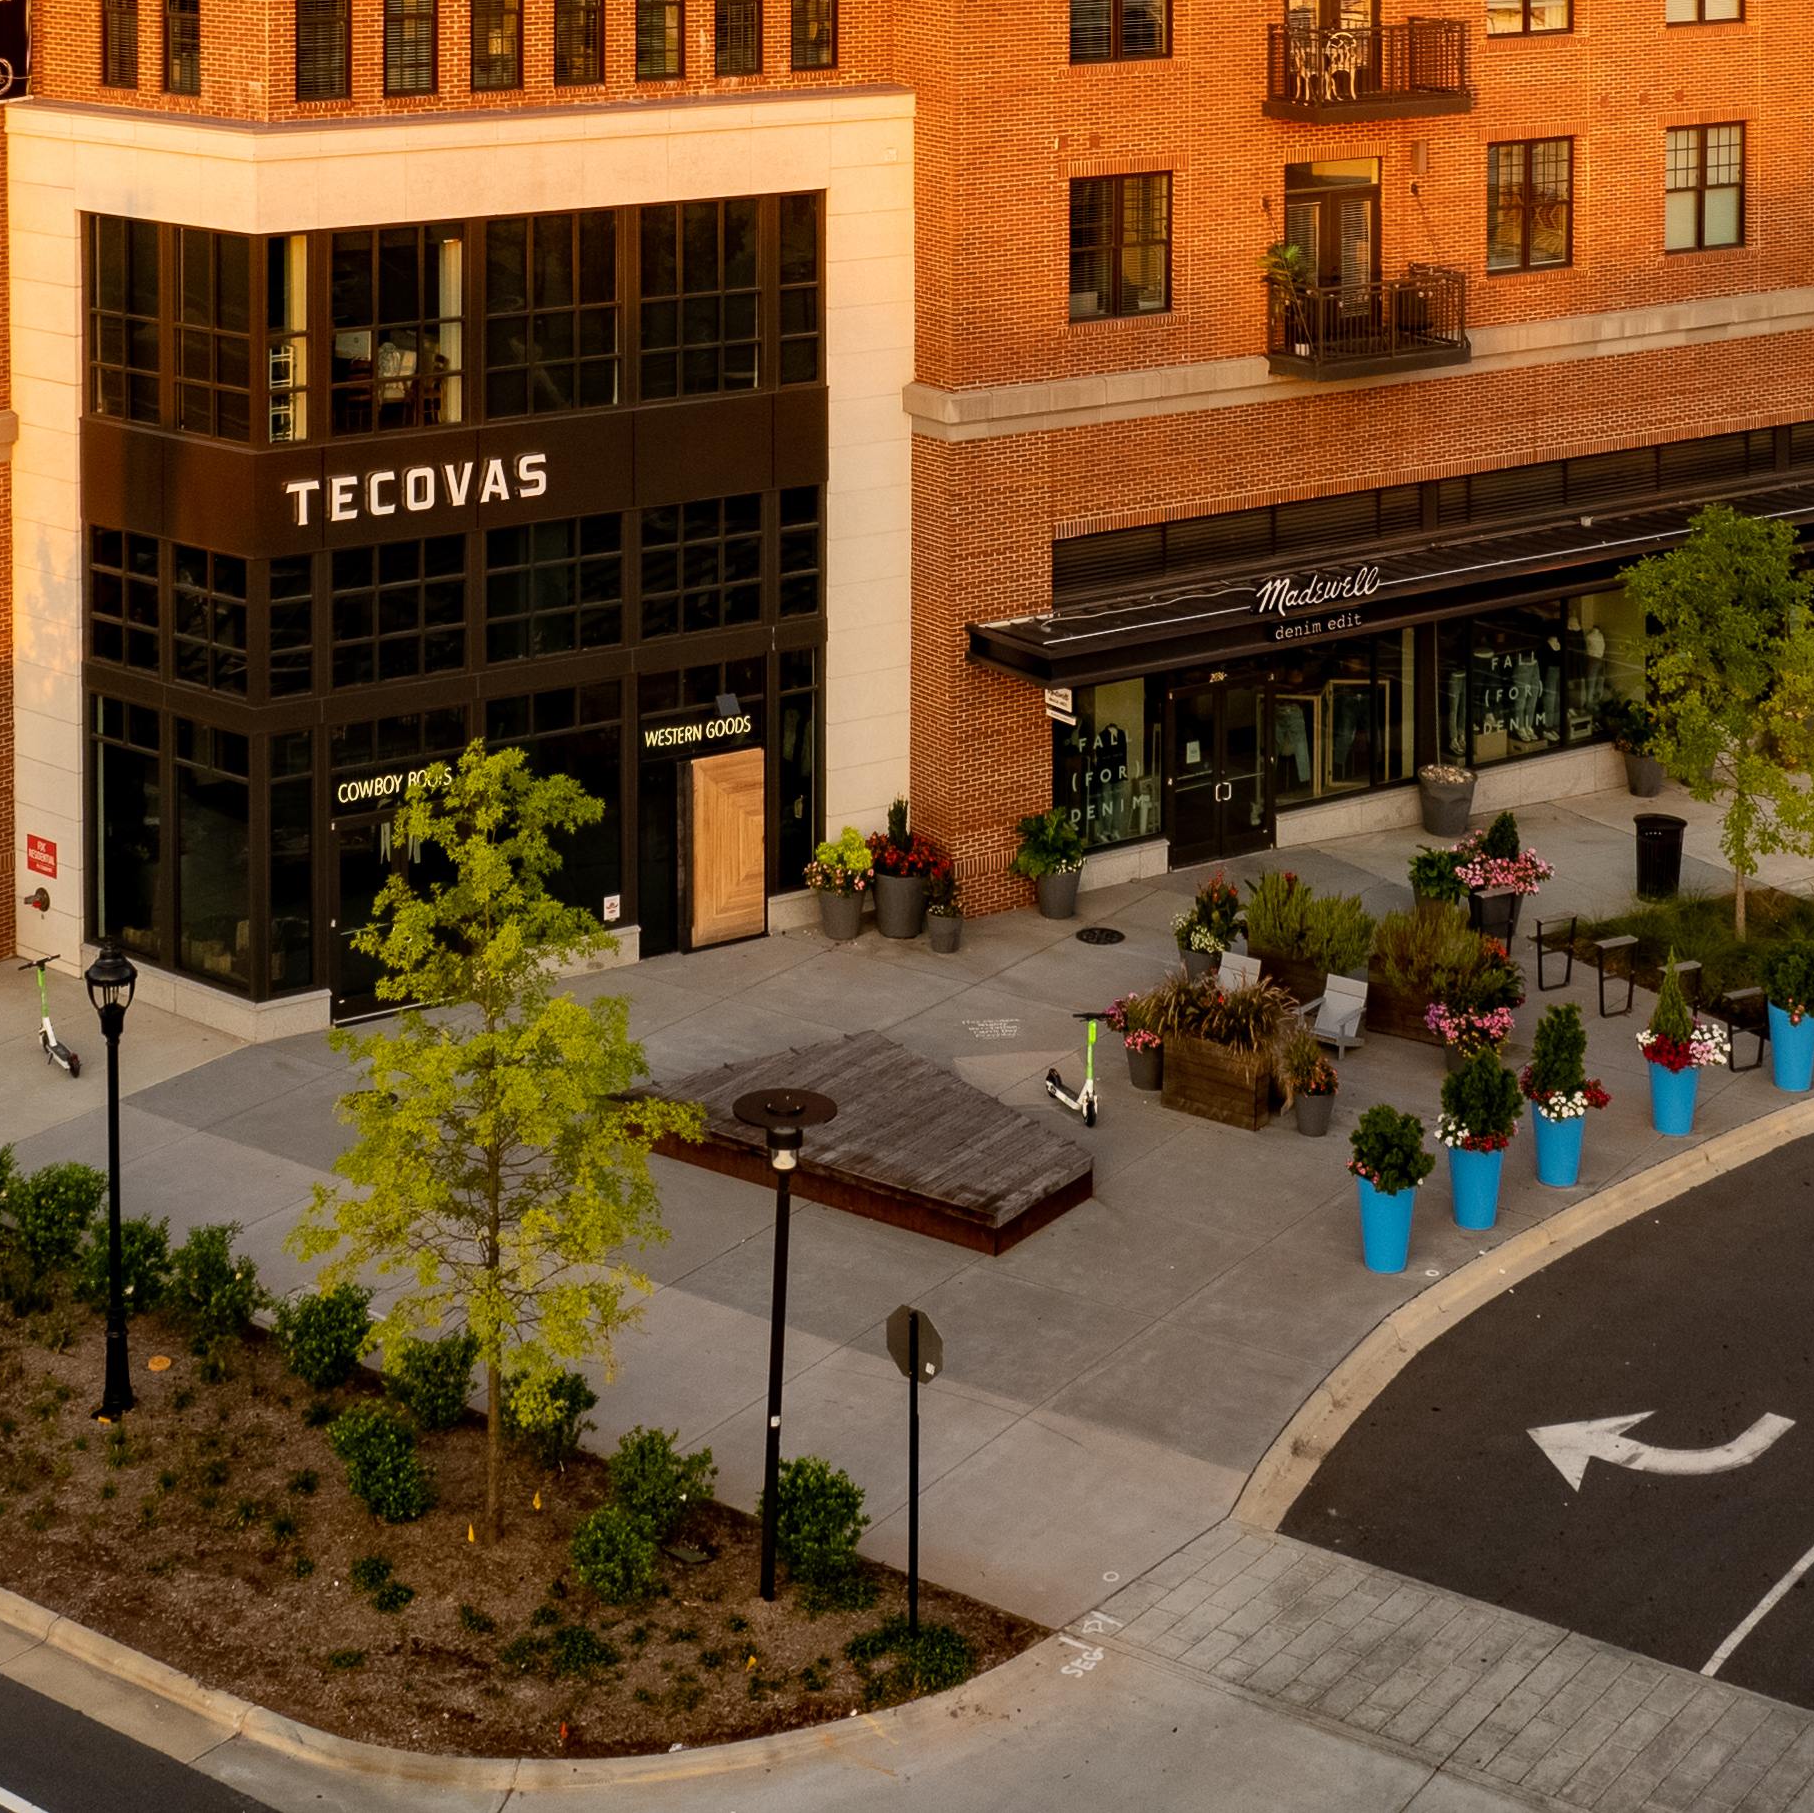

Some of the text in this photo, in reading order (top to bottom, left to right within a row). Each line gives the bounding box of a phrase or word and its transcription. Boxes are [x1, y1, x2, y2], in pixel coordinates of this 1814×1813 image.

[283, 452, 548, 527] TECOVAS
[1255, 566, 1381, 617] Madewell
[1275, 612, 1363, 641] denim edit
[1491, 650, 1539, 671] FALL
[1485, 679, 1544, 708] (FOR)
[644, 714, 752, 747] WESTERN GOODS
[1483, 712, 1546, 736] DENIM
[1078, 729, 1133, 753] FALL
[337, 774, 404, 804] COWBOY
[1071, 759, 1141, 793] (FOR)
[1070, 795, 1151, 824] DENIM
